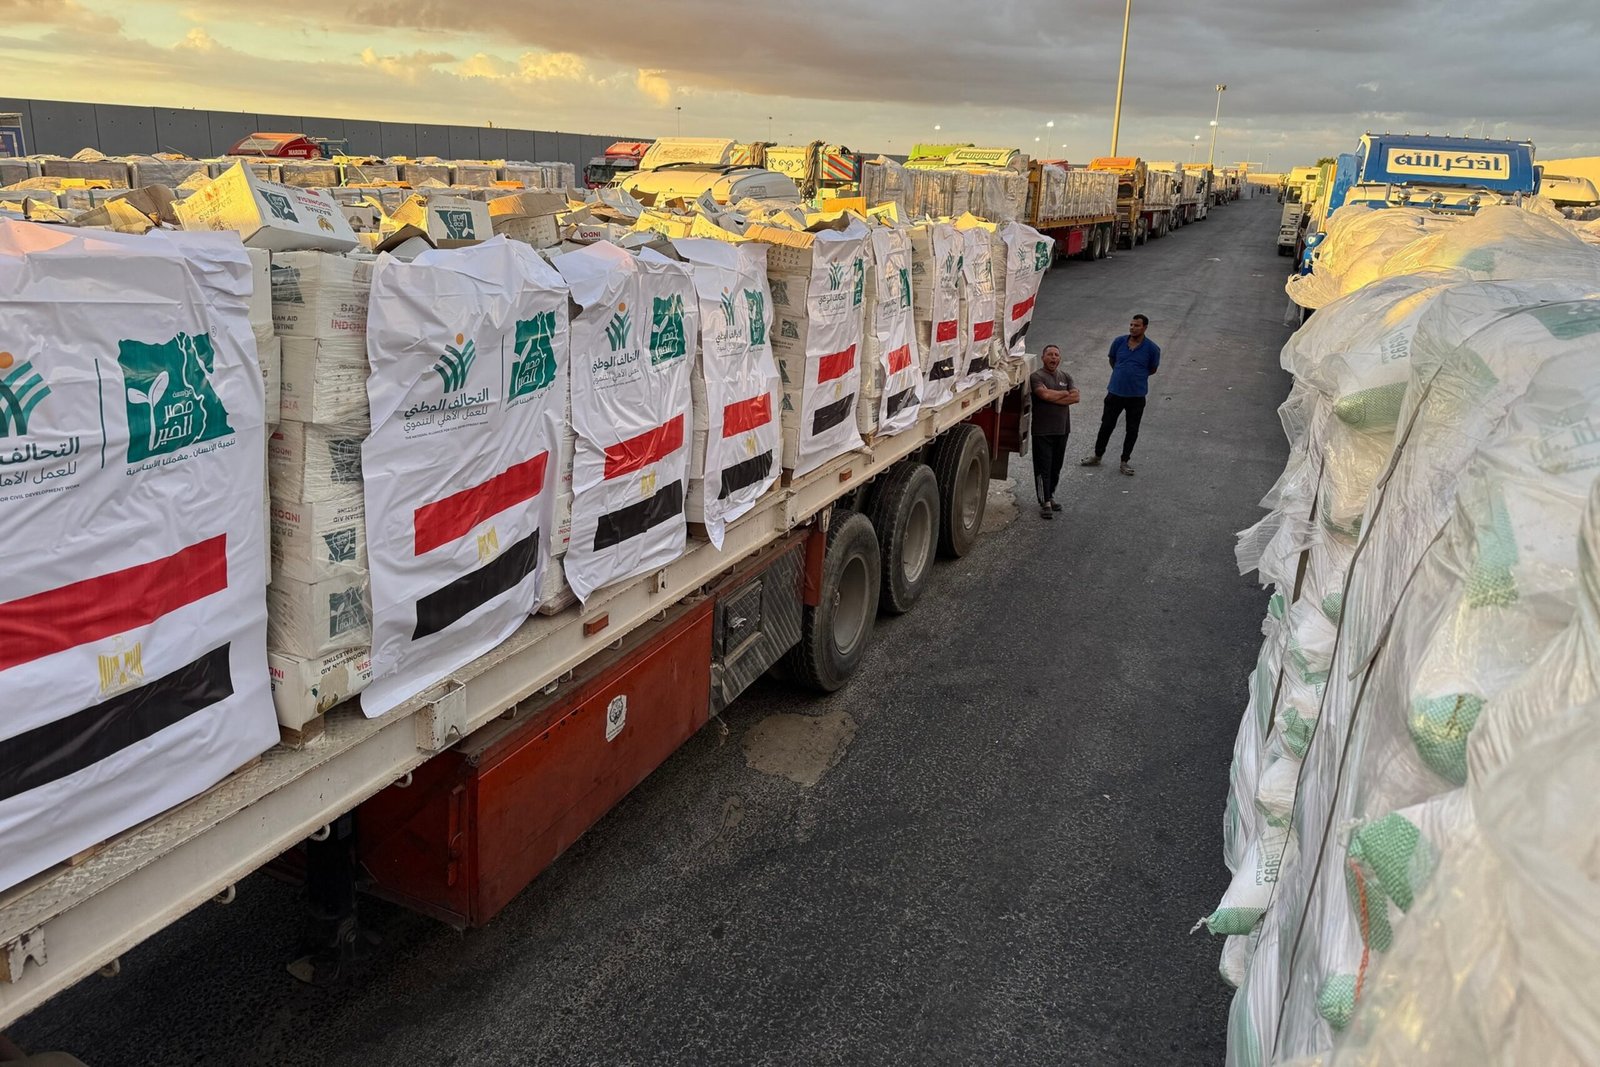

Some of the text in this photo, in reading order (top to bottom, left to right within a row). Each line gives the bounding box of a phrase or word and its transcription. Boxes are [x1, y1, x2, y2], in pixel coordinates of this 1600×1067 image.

[1394, 152, 1502, 171] اذكر الله
[164, 400, 194, 425] مصر
[404, 387, 489, 420] التحالف الوطني
[462, 405, 488, 420] للعمل
[153, 413, 193, 450] الخير
[403, 414, 435, 433] التنموي
[0, 436, 79, 465] التحالف
[33, 461, 77, 485] للعمل
